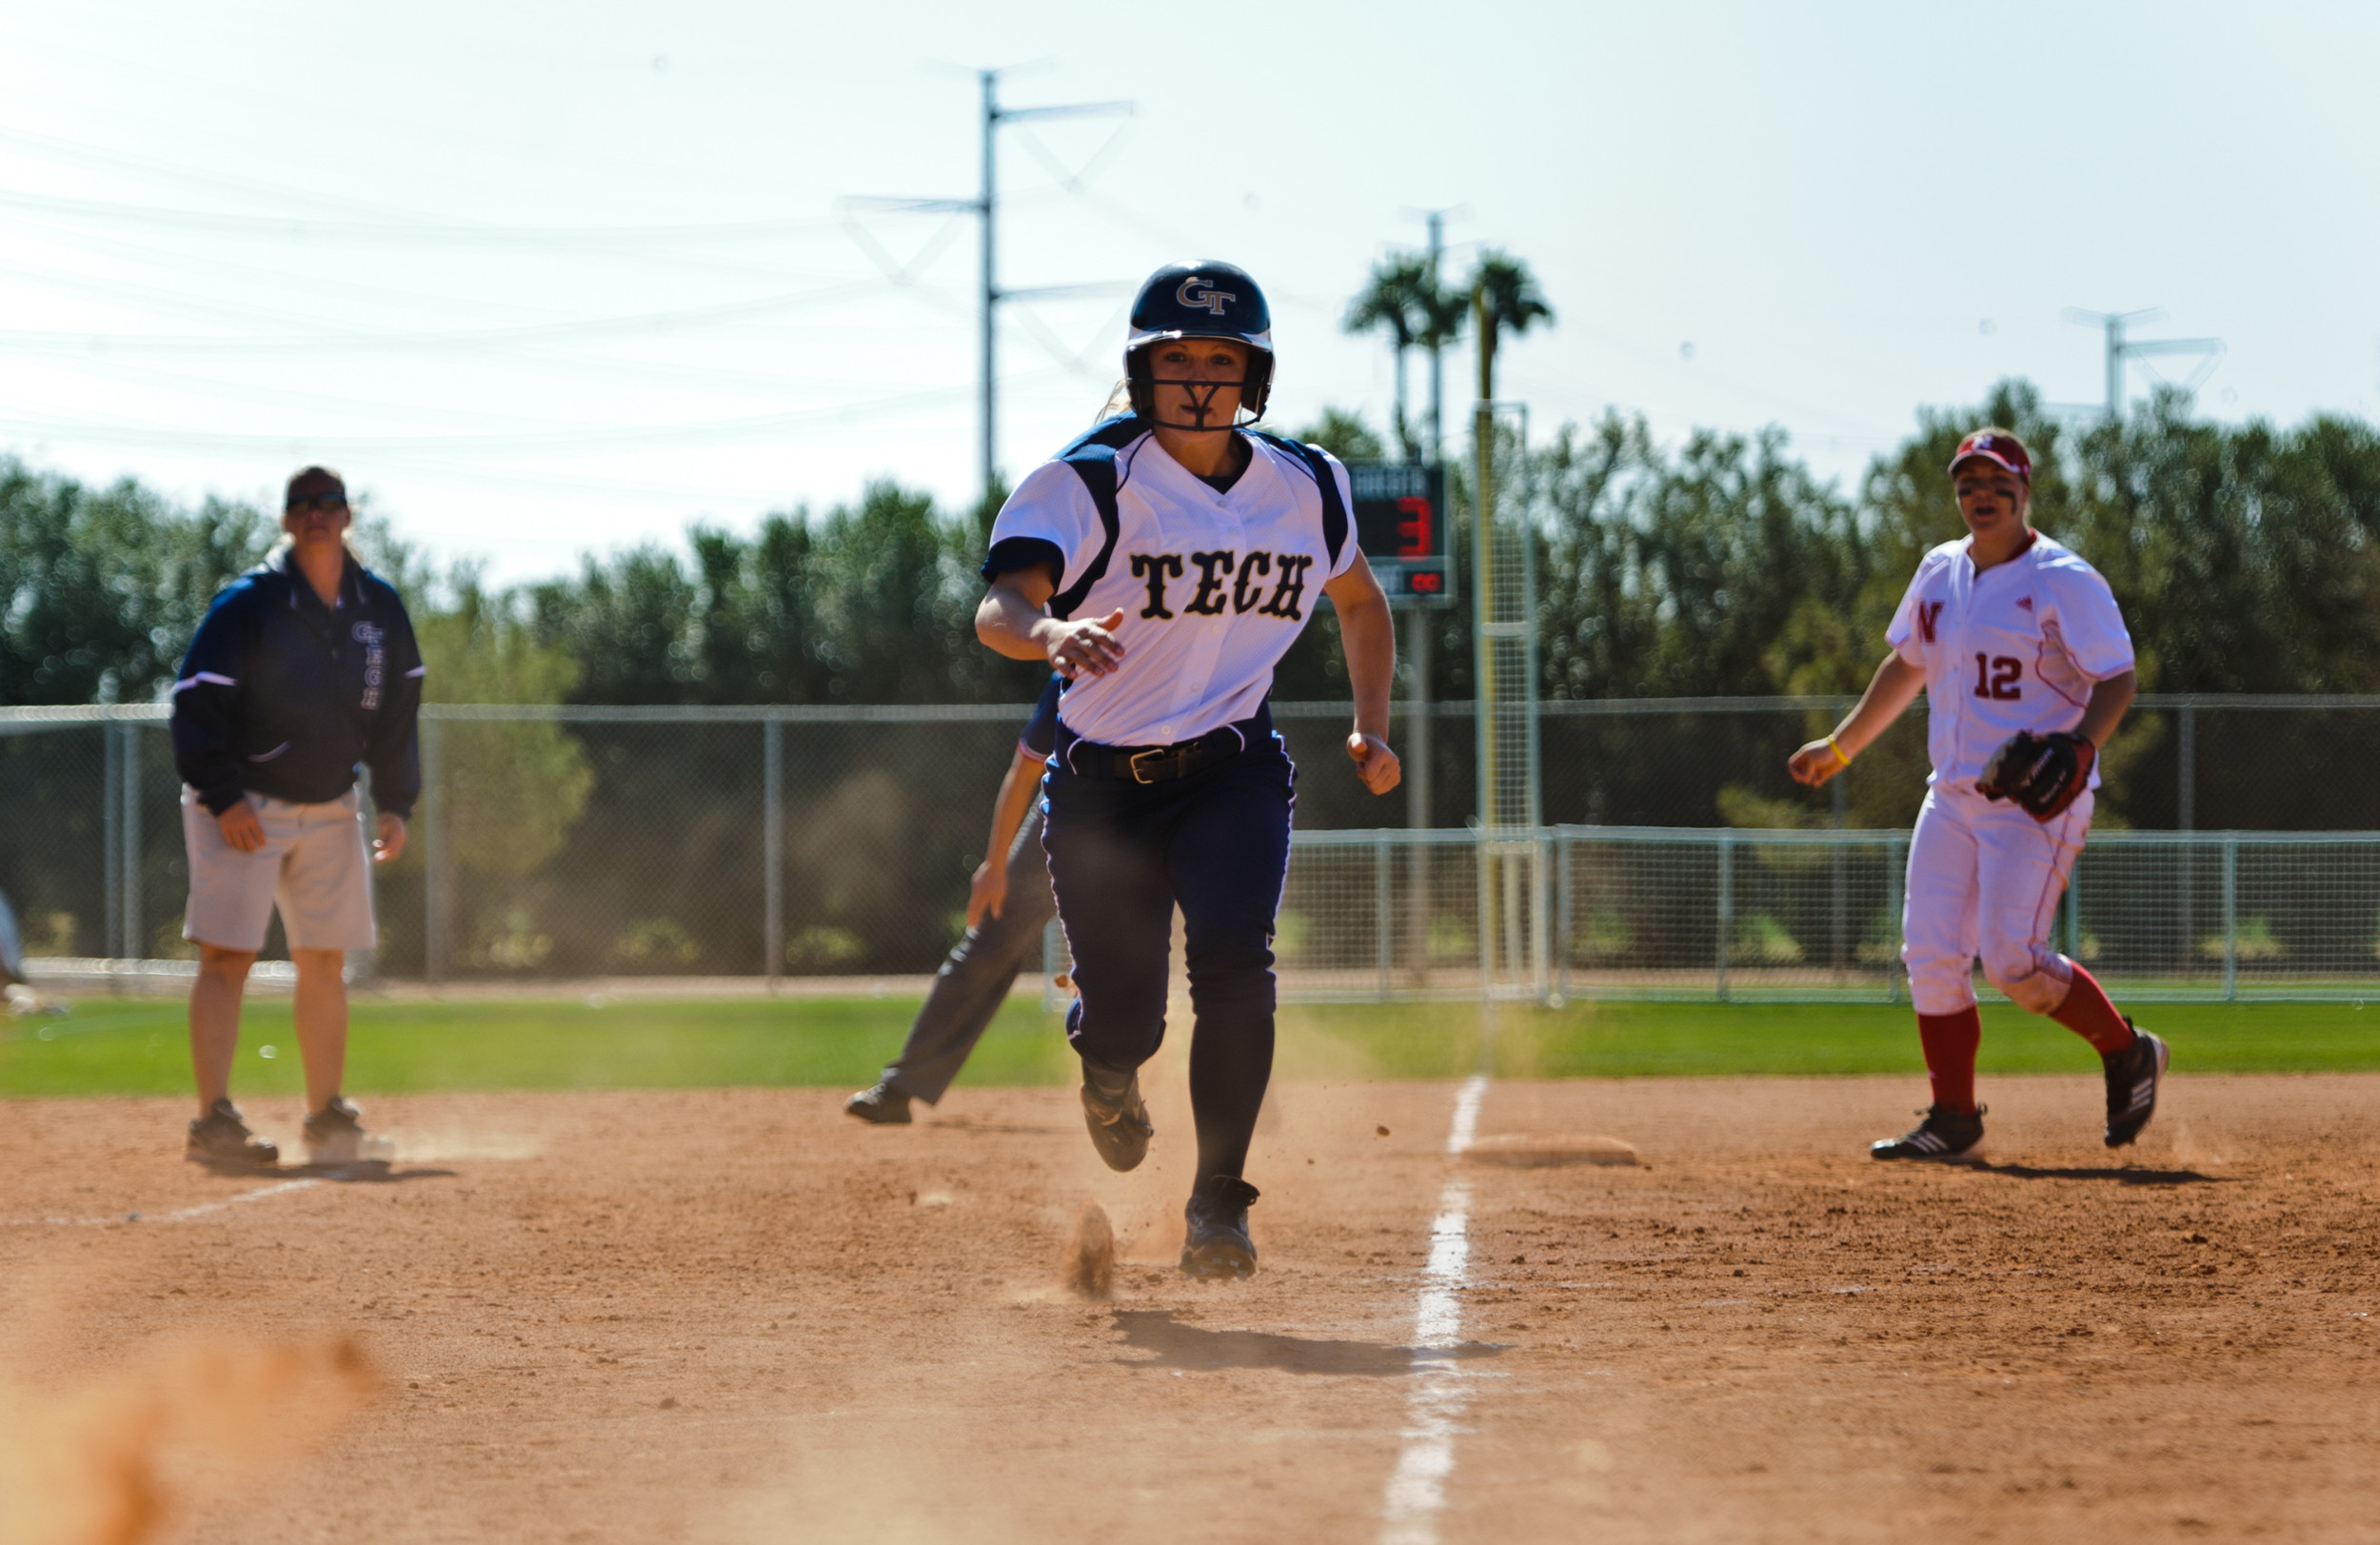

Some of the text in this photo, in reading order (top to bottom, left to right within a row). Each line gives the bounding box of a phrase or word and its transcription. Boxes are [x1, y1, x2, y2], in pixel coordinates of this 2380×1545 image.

[1177, 277, 1236, 315] GT
[1397, 496, 1432, 562] 3
[1129, 549, 1313, 621] TECH
[1974, 652, 2023, 700] 12
